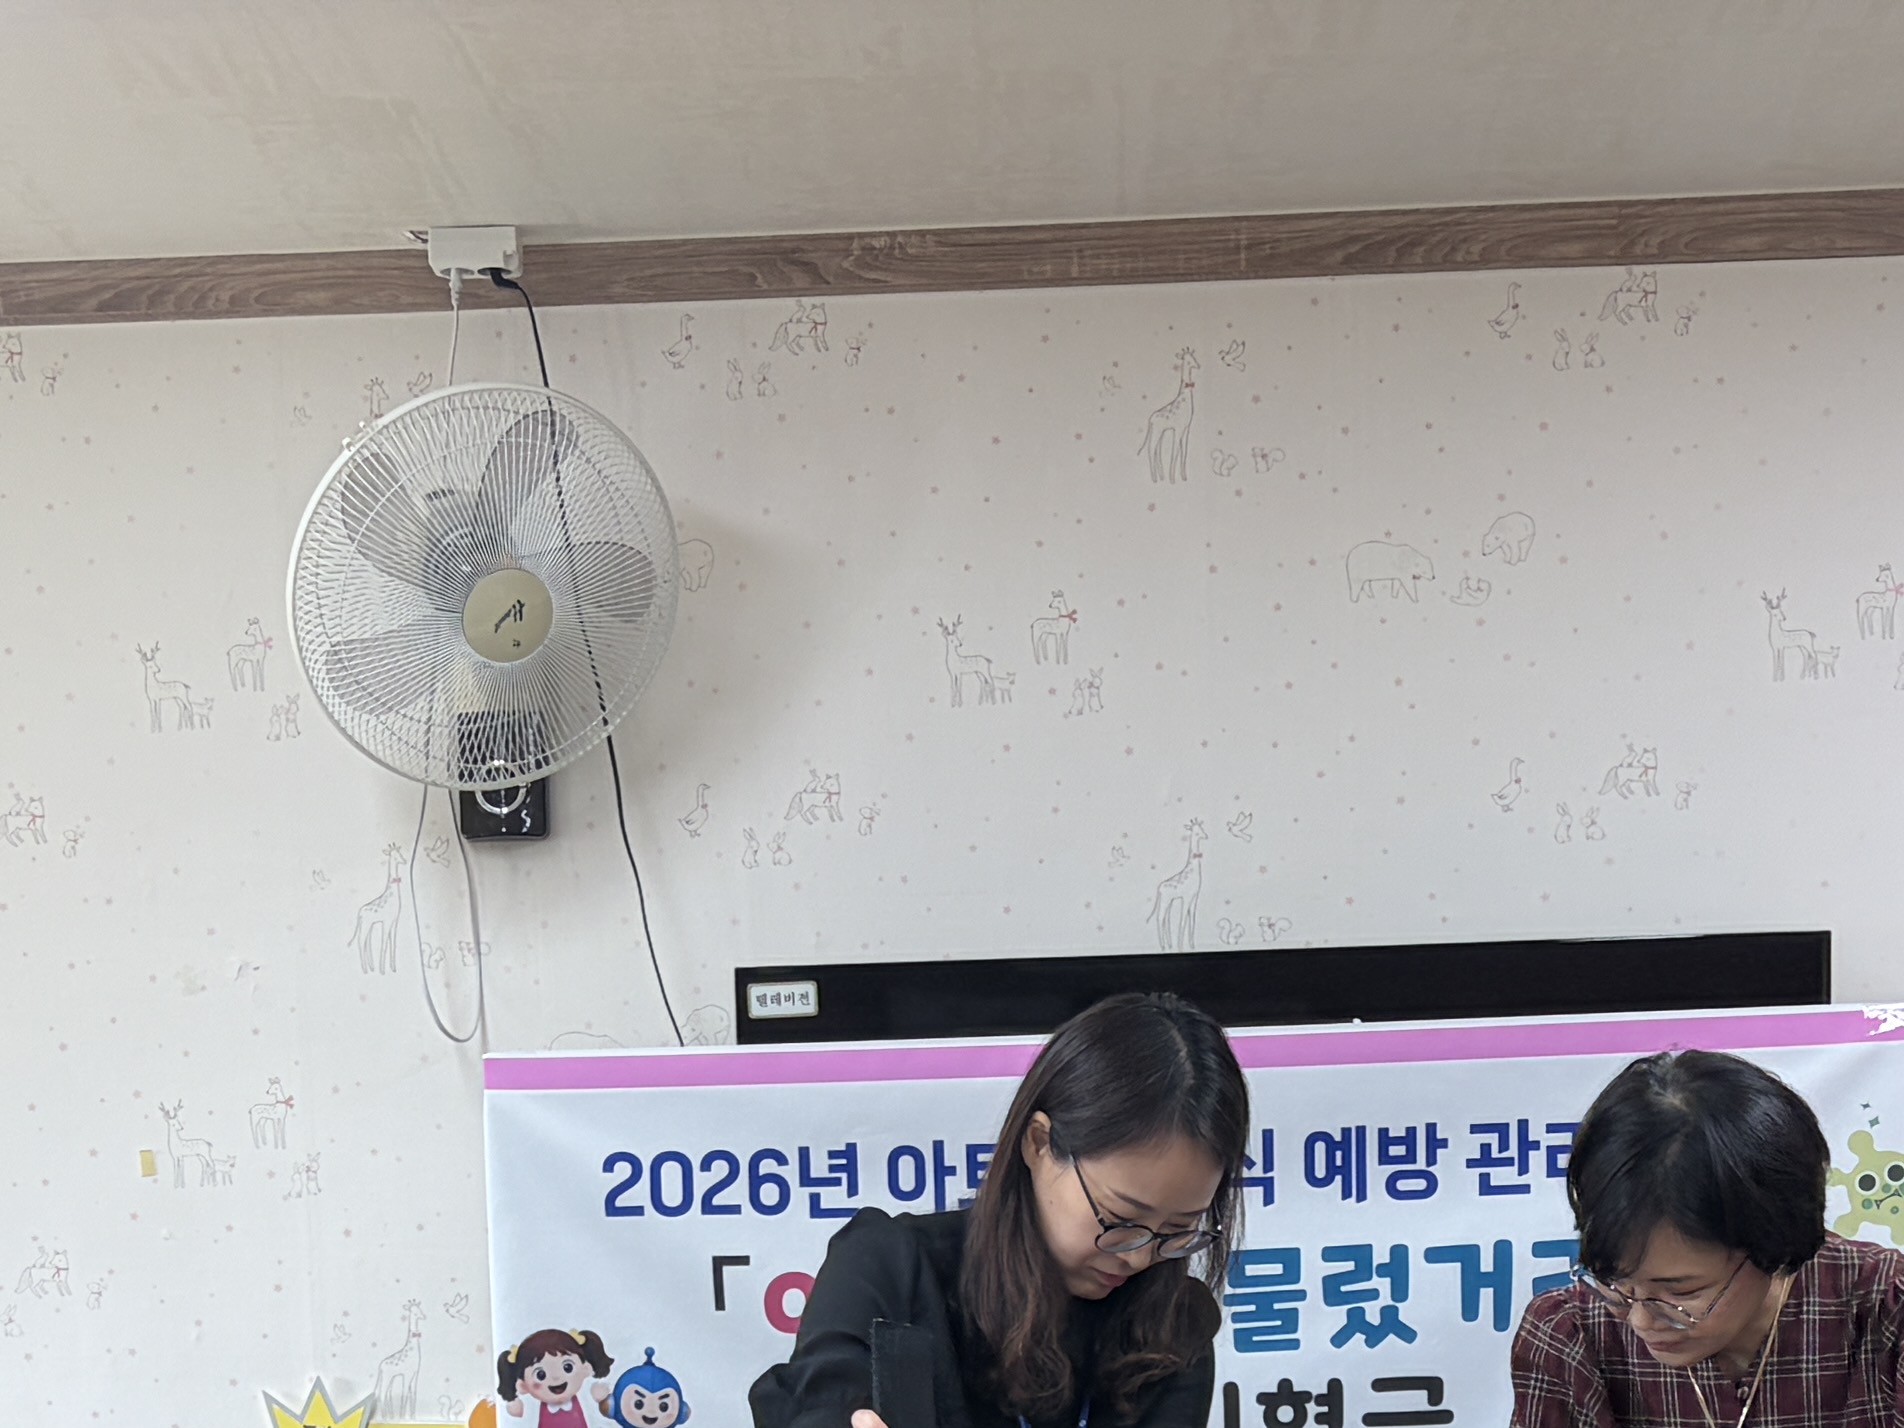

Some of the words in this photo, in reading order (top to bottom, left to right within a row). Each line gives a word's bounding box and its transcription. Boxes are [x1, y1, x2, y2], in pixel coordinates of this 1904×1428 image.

[756, 991, 811, 1008] 텔레비전
[601, 1142, 859, 1219] 2026년
[1303, 1122, 1449, 1202] 예방
